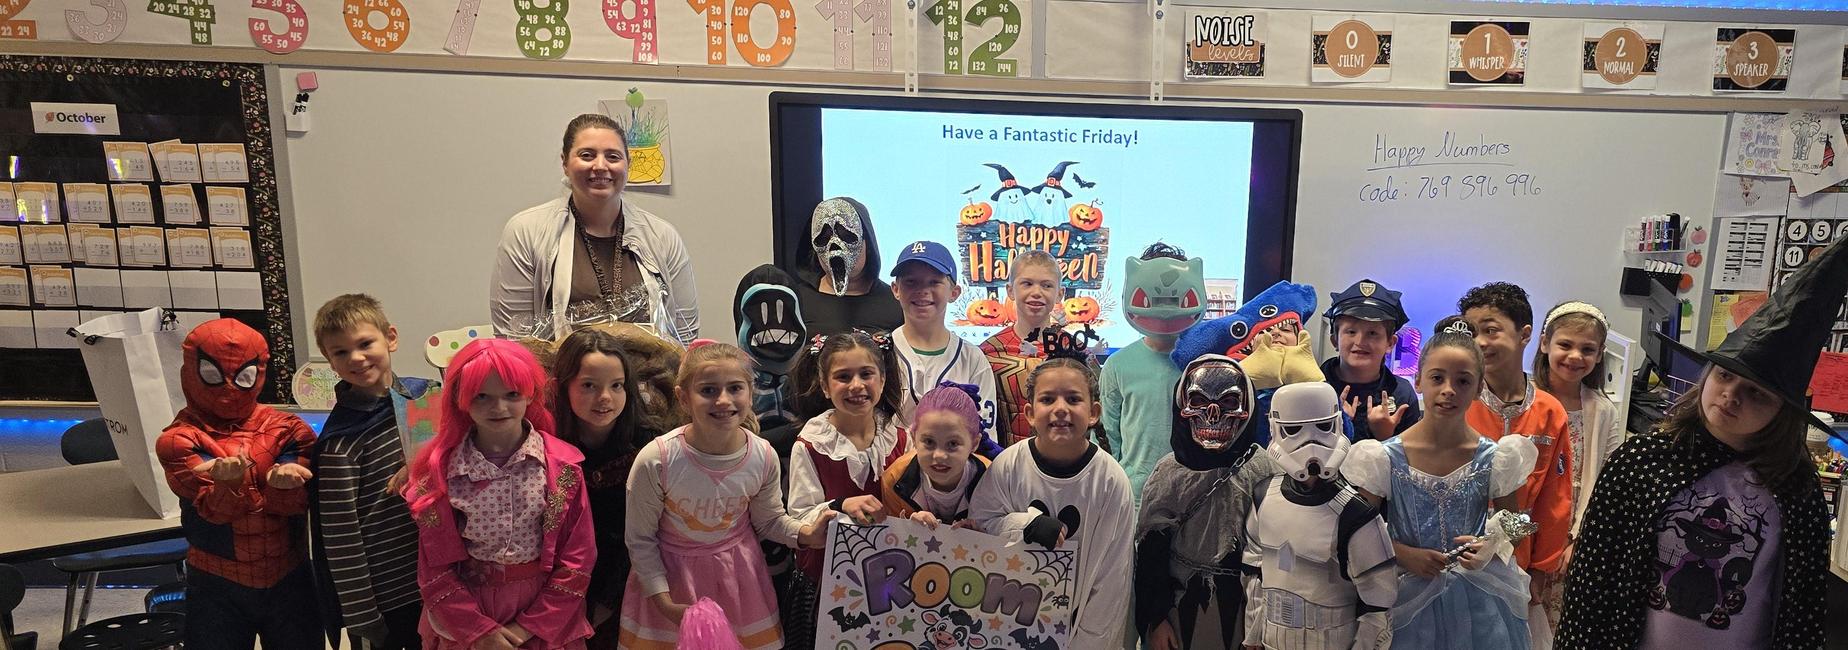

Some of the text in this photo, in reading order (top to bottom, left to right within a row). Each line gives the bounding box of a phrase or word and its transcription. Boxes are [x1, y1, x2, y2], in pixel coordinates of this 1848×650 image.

[286, 3, 297, 13] 35
[347, 5, 360, 14] 24
[518, 1, 531, 10] 40
[555, 2, 561, 12] 8
[947, 0, 958, 10] 24
[998, 3, 1009, 13] 96
[153, 3, 211, 19] 20 24 28 32
[390, 8, 402, 16] 60
[607, 11, 619, 20] 54
[643, 8, 649, 17] 9
[711, 6, 722, 15] 30
[735, 6, 749, 16] 120
[780, 9, 791, 18] 80
[935, 5, 944, 16] 12
[975, 6, 987, 16] 84
[292, 18, 305, 28] 40
[352, 18, 364, 28] 30
[526, 15, 539, 24] 48
[544, 15, 556, 24] 96
[642, 19, 652, 29] 81
[947, 15, 958, 26] 36
[194, 21, 207, 31] 44
[253, 22, 266, 31] 60
[393, 21, 405, 31] 54
[616, 22, 627, 31] 63
[630, 24, 641, 34] 72
[711, 21, 722, 30] 40
[1004, 23, 1019, 34] 108
[1, 27, 29, 36] 22 24
[361, 31, 372, 41] 36
[520, 27, 531, 36] 56
[555, 27, 567, 36] 88
[947, 31, 959, 41] 48
[1194, 15, 1255, 47] NOISE
[195, 33, 208, 43] 48
[262, 35, 273, 44] 55
[291, 32, 302, 42] 45
[386, 32, 399, 42] 48
[642, 32, 653, 41] 90
[711, 36, 722, 46] 50
[737, 33, 749, 43] 110
[782, 36, 792, 46] 90
[924, 0, 1019, 77] 12
[1345, 30, 1358, 50] 0
[277, 38, 289, 49] 50
[374, 37, 387, 48] 42
[524, 41, 536, 50] 64
[552, 40, 565, 49] 80
[640, 43, 651, 52] 99
[988, 42, 1002, 52] 120
[1484, 32, 1492, 56] 1
[1615, 36, 1627, 58] 2
[539, 47, 550, 57] 72
[948, 46, 959, 56] 60
[1208, 44, 1255, 62] levels
[1748, 41, 1759, 60] 3
[638, 53, 653, 62] 108
[711, 52, 722, 60] 60
[757, 53, 771, 62] 100
[1337, 53, 1364, 69] SILENT
[948, 60, 958, 70] 72
[972, 61, 986, 72] 132
[997, 63, 1011, 73] 144
[1469, 56, 1505, 71] WHISPER
[1603, 61, 1635, 76] NORMAL
[1733, 61, 1769, 78] SPEAKER
[56, 112, 107, 125] October
[942, 124, 1138, 148] Have a Fantastic Friday!
[1375, 131, 1511, 168] Happy Numbers
[1418, 175, 1453, 199] 769
[1505, 173, 1542, 197] 996
[1793, 225, 1801, 236] 4
[1818, 225, 1826, 238] 5
[999, 223, 1070, 257] Happy
[912, 242, 926, 254] LA
[1788, 250, 1800, 262] 11
[1043, 327, 1088, 353] BOO
